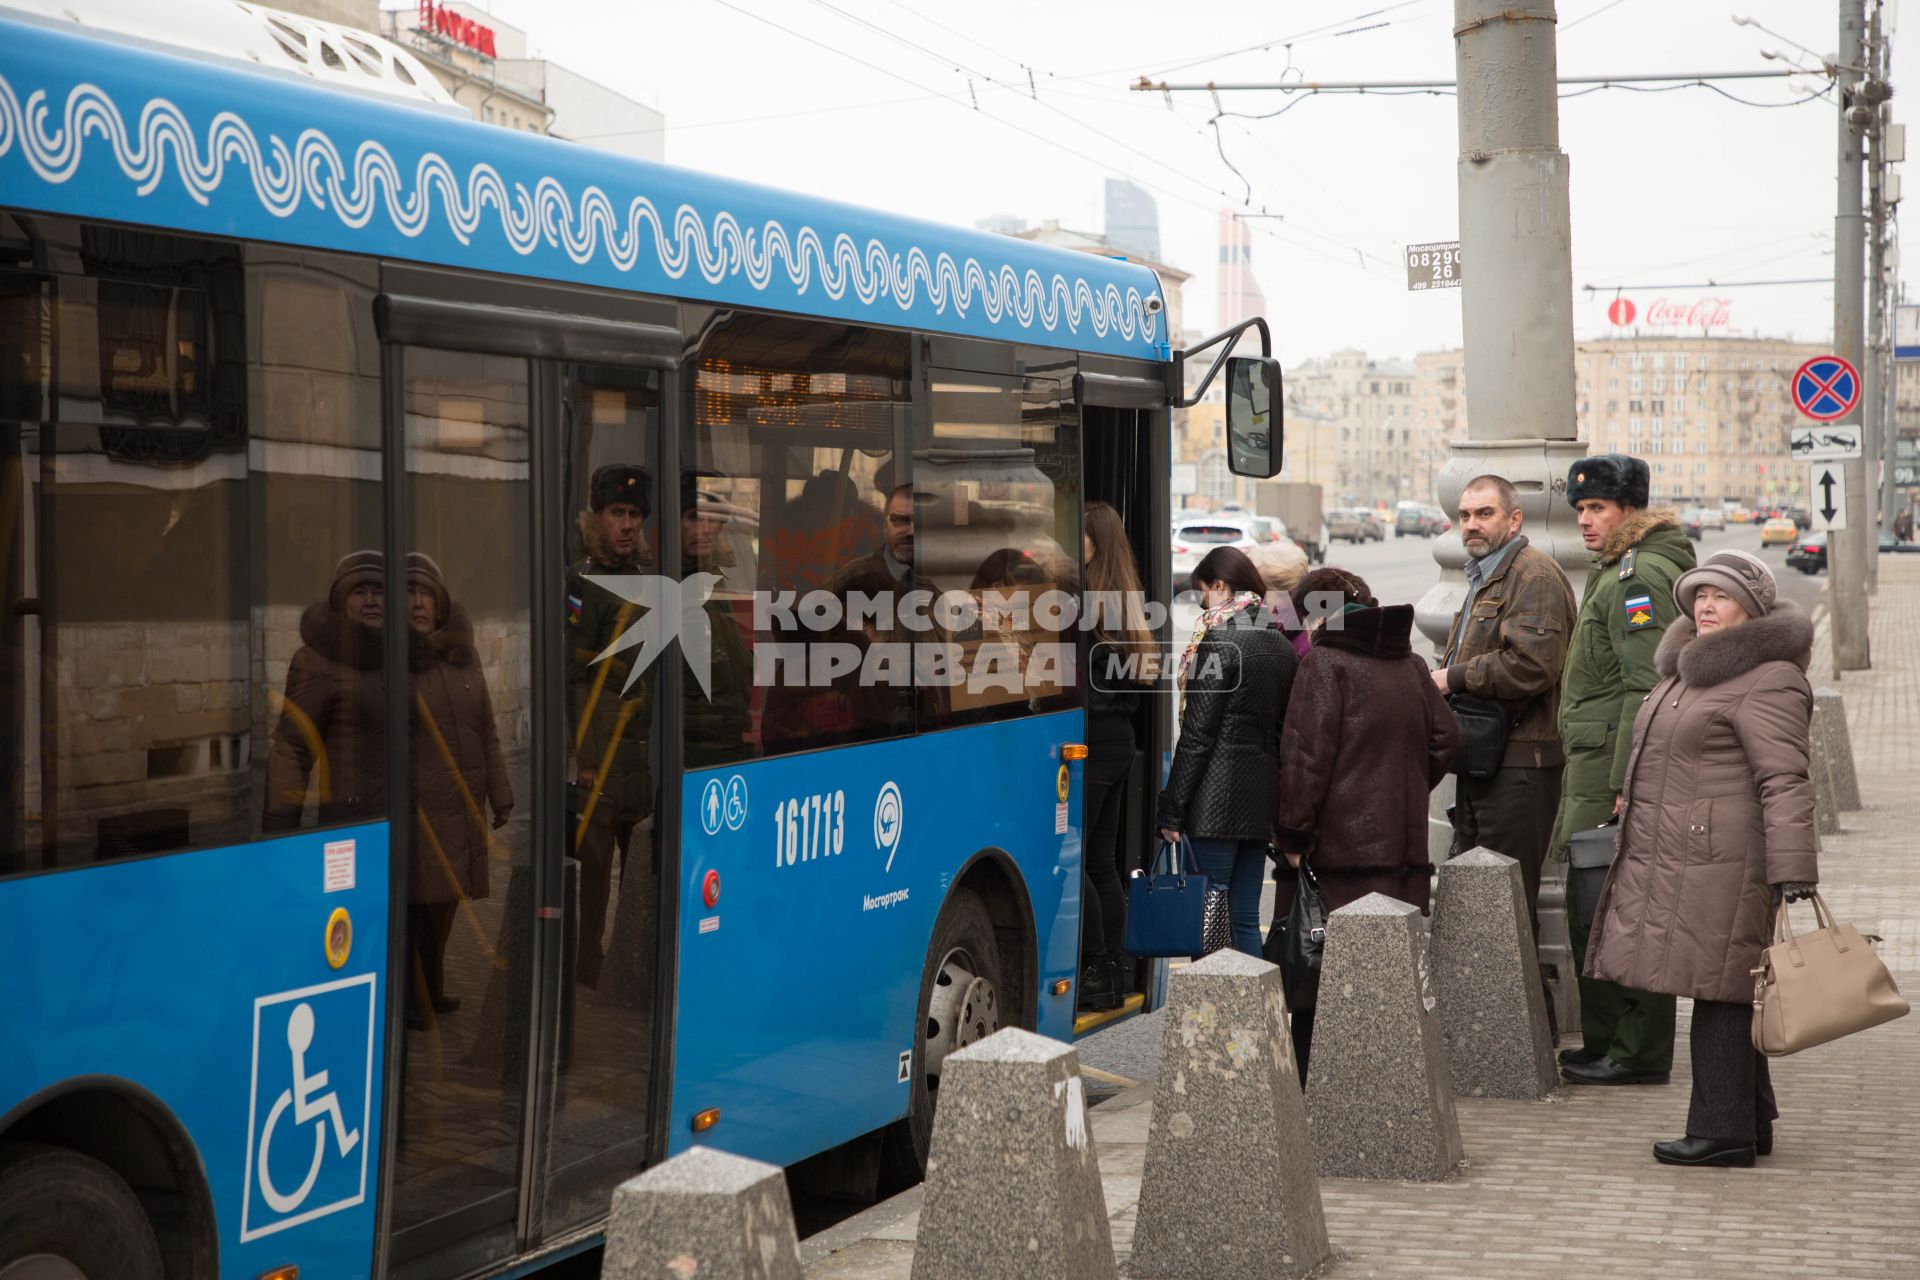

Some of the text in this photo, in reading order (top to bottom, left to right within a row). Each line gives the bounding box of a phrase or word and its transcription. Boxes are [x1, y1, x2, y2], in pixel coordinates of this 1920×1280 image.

[1408, 243, 1460, 253] Мосгортран
[1432, 265, 1453, 279] 26
[774, 789, 845, 868] 161713
[863, 888, 909, 912] Мосгортранс
